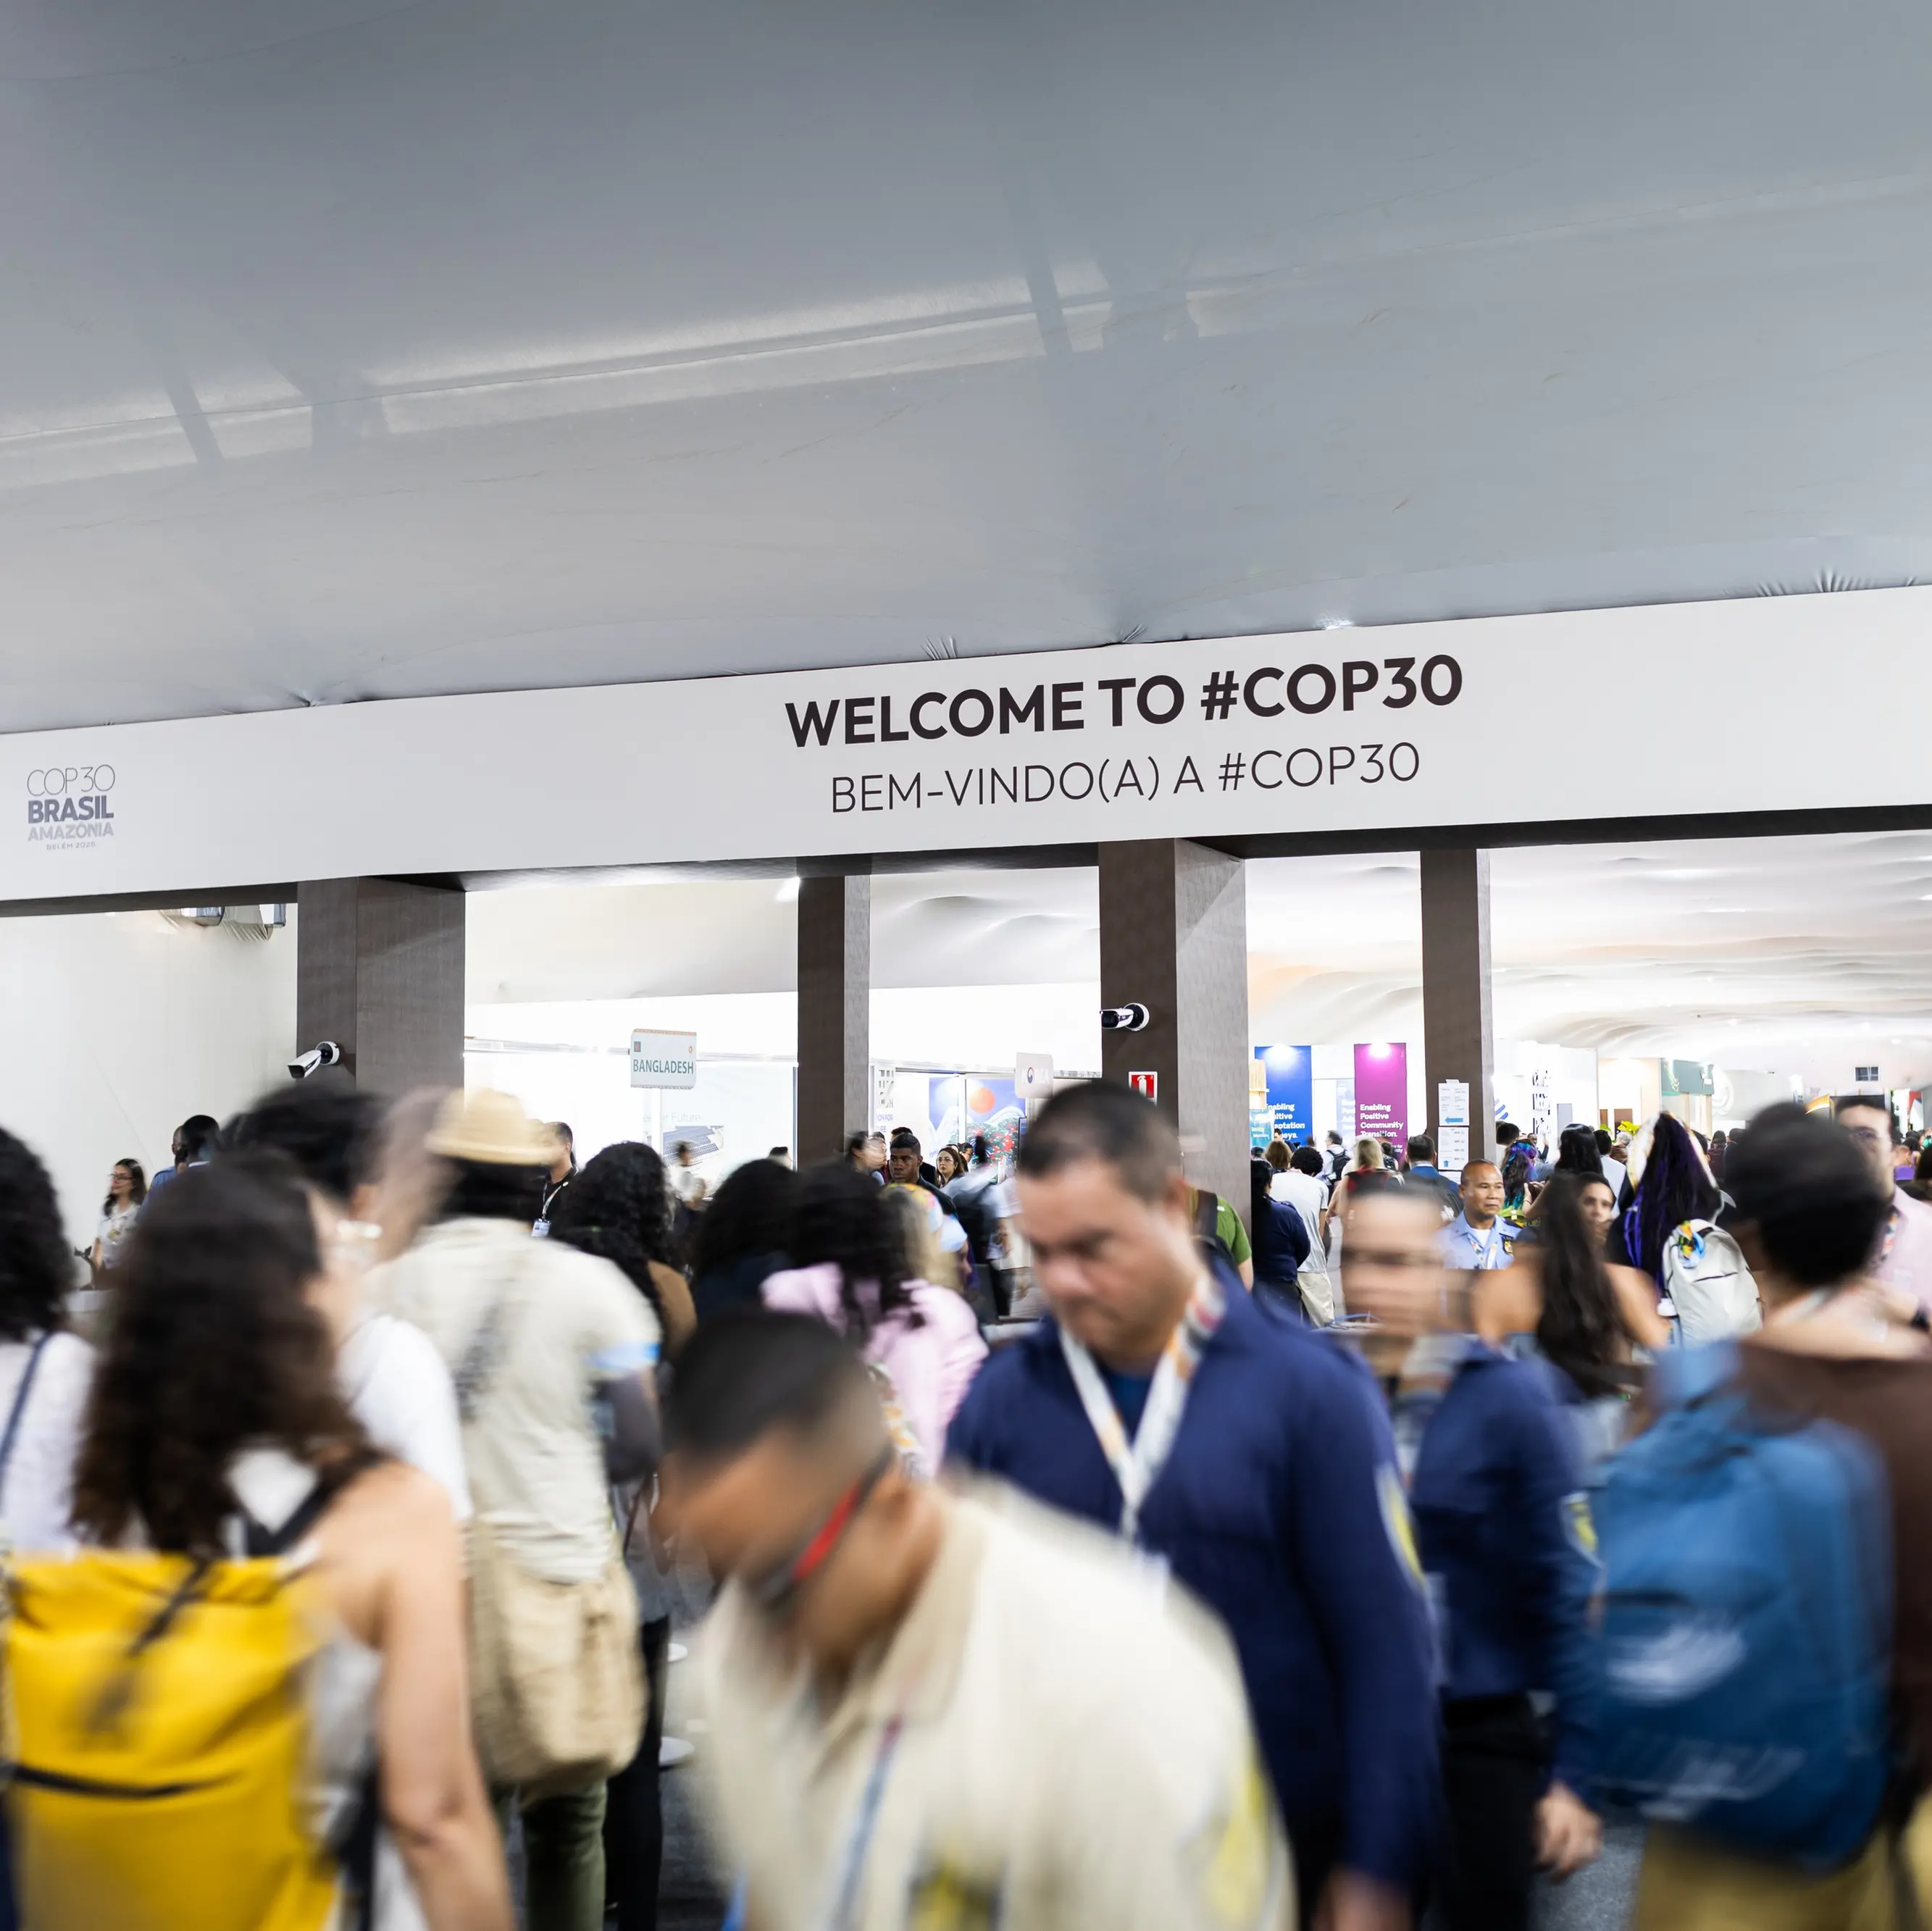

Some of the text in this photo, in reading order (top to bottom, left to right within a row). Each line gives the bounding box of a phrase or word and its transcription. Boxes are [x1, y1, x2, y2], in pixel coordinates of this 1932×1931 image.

[785, 654, 1463, 748] WELCOME TO #COP30
[27, 763, 115, 797] COP30
[832, 742, 1420, 813] BEM-VINDO(A) A #COP30
[28, 795, 114, 824] BRASIL
[28, 821, 114, 842] AMAZÔNIA
[633, 1058, 694, 1075] BANGLADESH
[1360, 1104, 1392, 1113] Enabling
[1360, 1121, 1404, 1130] Community
